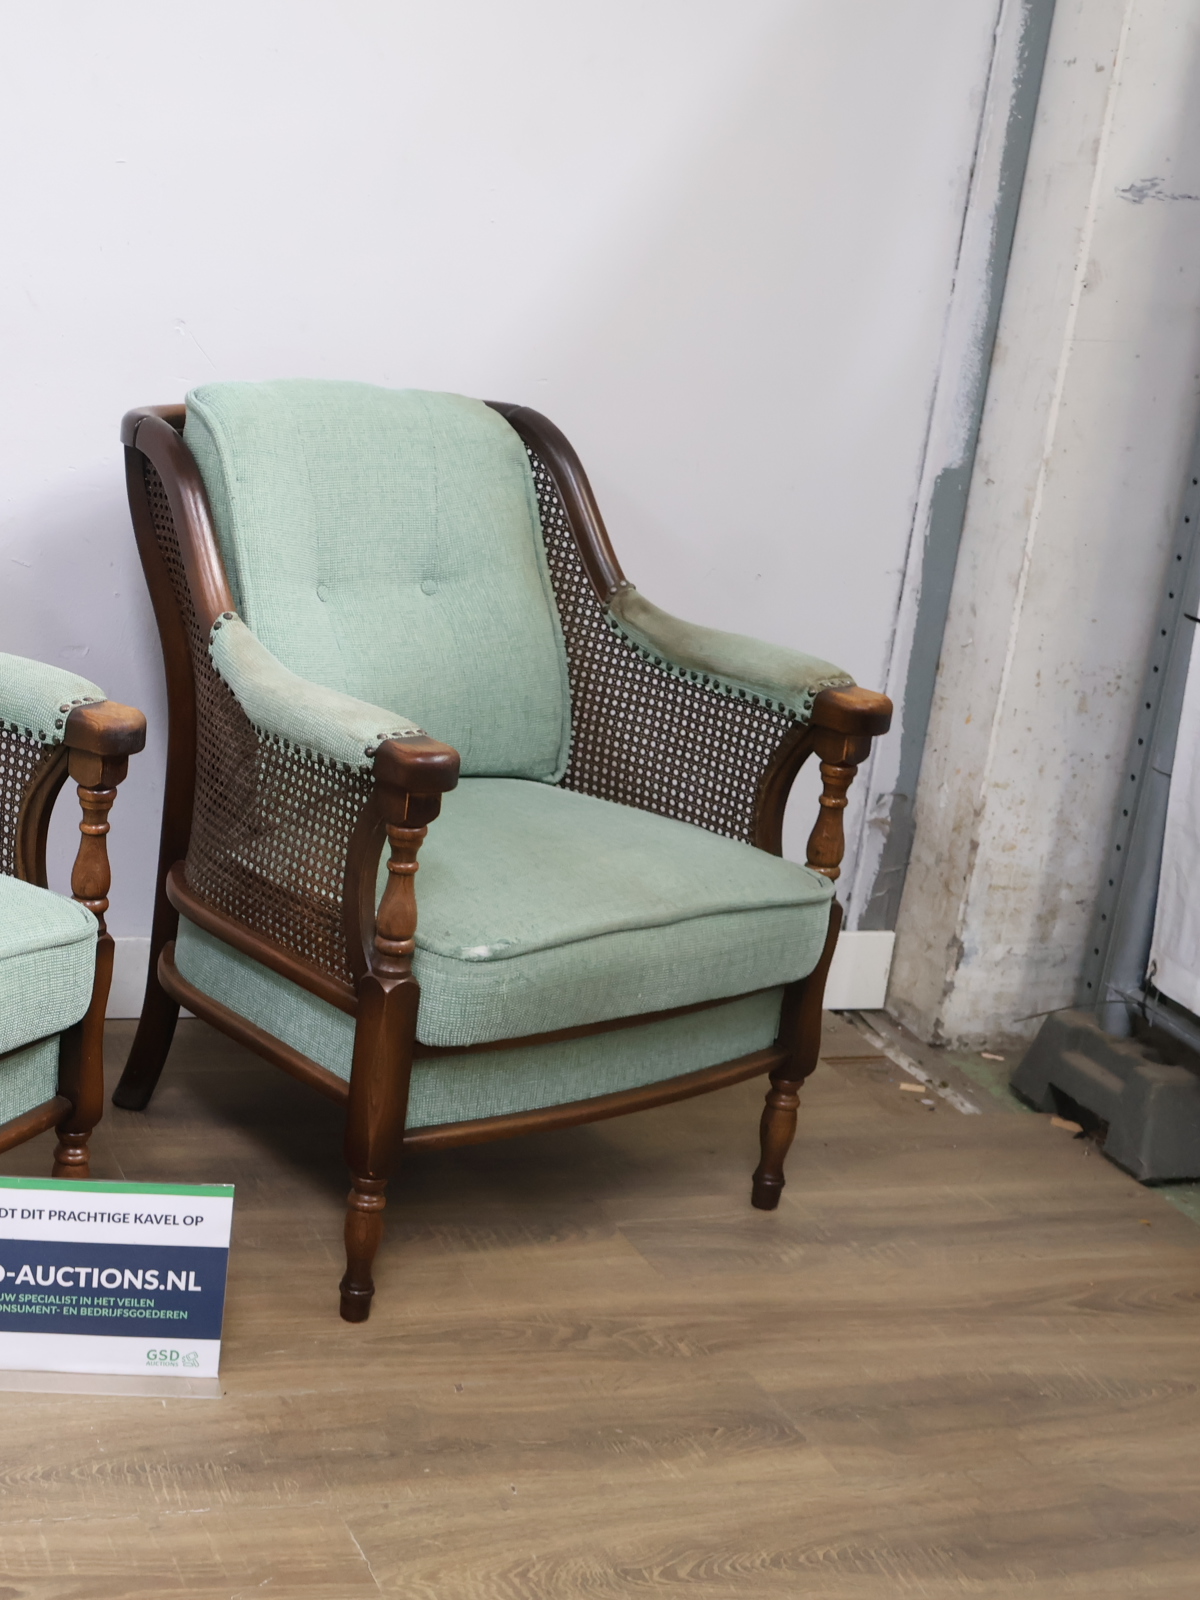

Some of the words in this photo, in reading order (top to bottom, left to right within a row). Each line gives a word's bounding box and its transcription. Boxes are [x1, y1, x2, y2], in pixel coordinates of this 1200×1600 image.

[20, 1208, 44, 1220] DIT
[48, 1209, 130, 1224] PRACHTIGE
[134, 1213, 180, 1226] KAVEL
[183, 1215, 204, 1227] OP
[18, 1293, 78, 1305] SPECIALIST
[79, 1296, 92, 1305] IN
[94, 1296, 116, 1306] HET
[117, 1297, 155, 1308] VEILEN
[62, 1306, 78, 1316] EN
[80, 1307, 188, 1320] BEDRIJFSGOEDEREN
[146, 1349, 180, 1362] GSD
